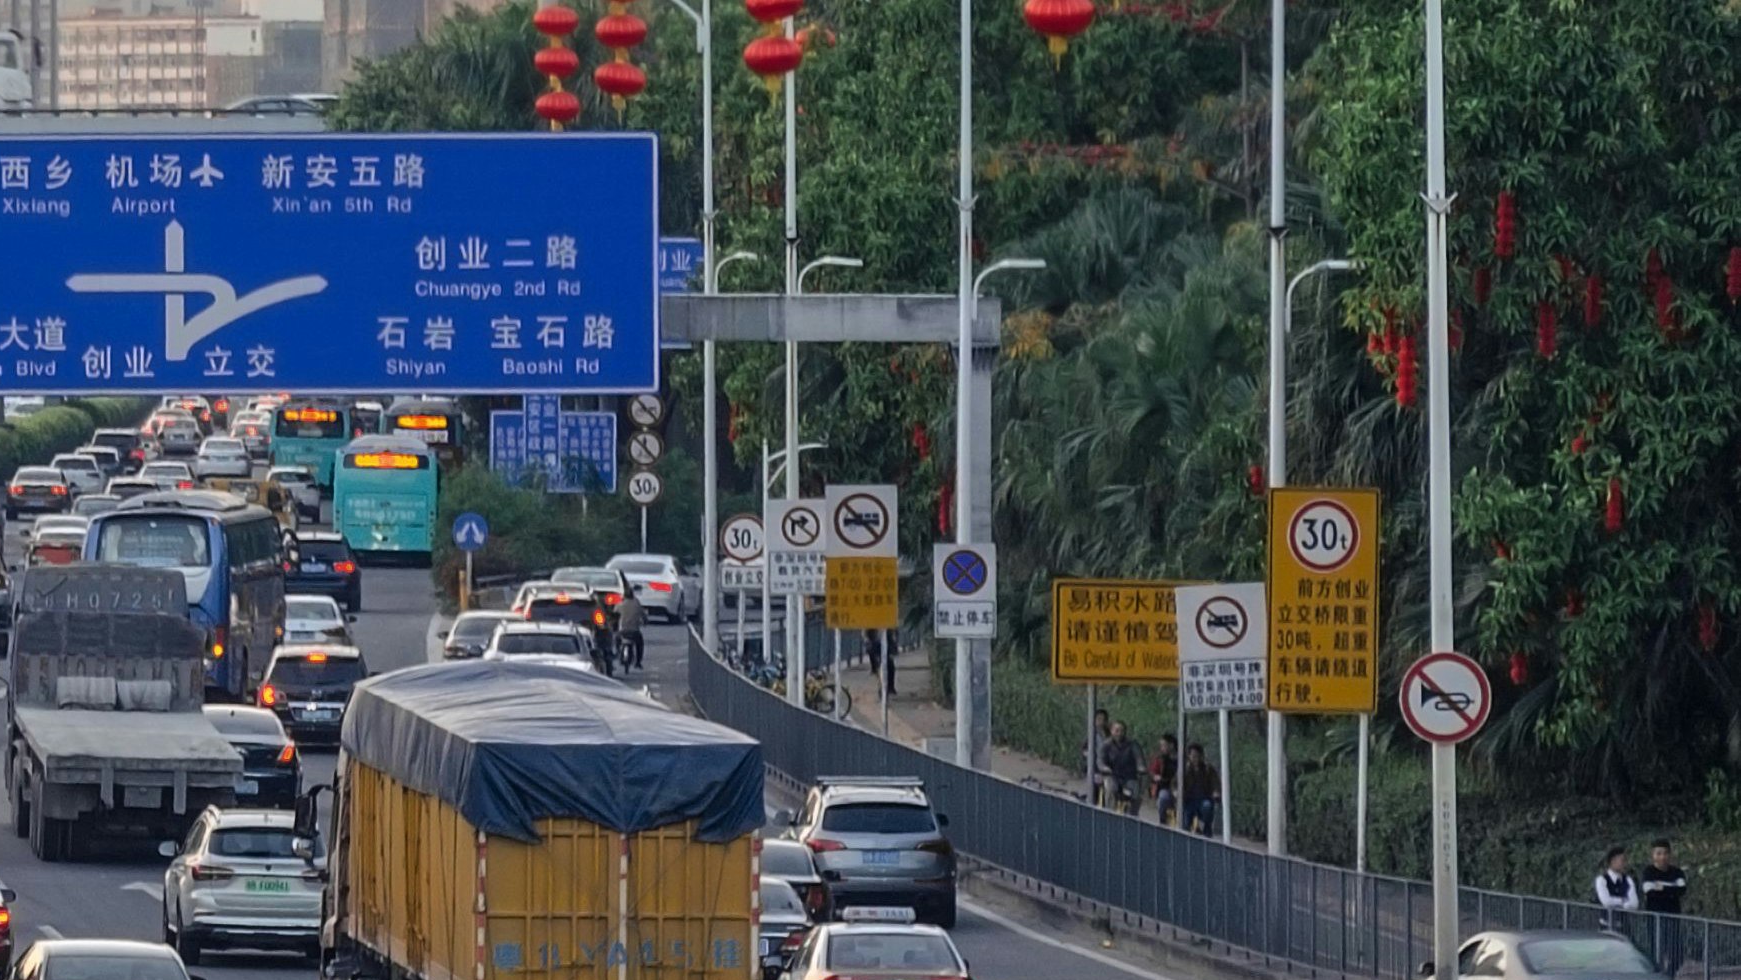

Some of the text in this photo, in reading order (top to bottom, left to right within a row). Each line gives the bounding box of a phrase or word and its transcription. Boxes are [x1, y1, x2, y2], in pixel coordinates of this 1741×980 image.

[0, 155, 73, 190] 西乡
[105, 154, 182, 189] 机场
[262, 153, 425, 189] 新安五路
[3, 198, 70, 216] Xixiang
[112, 197, 176, 216] Airport
[345, 197, 373, 212] 5th
[387, 197, 412, 212] Rd
[415, 235, 578, 271] 创业二路
[415, 280, 581, 299] Chuangye 2nd Rd
[376, 315, 615, 351] 石岩 宝石路
[16, 360, 56, 376] Blvd
[81, 344, 277, 380] 创业 立交
[386, 358, 600, 378] Shiyan Baoshi Rd
[1301, 519, 1348, 550] 30t
[1297, 578, 1370, 599] 前方创业
[1277, 602, 1368, 626] 立交桥限重
[1063, 652, 1078, 669] Be
[1084, 652, 1120, 669] Careful
[1277, 656, 1369, 678] 车辆请绕道
